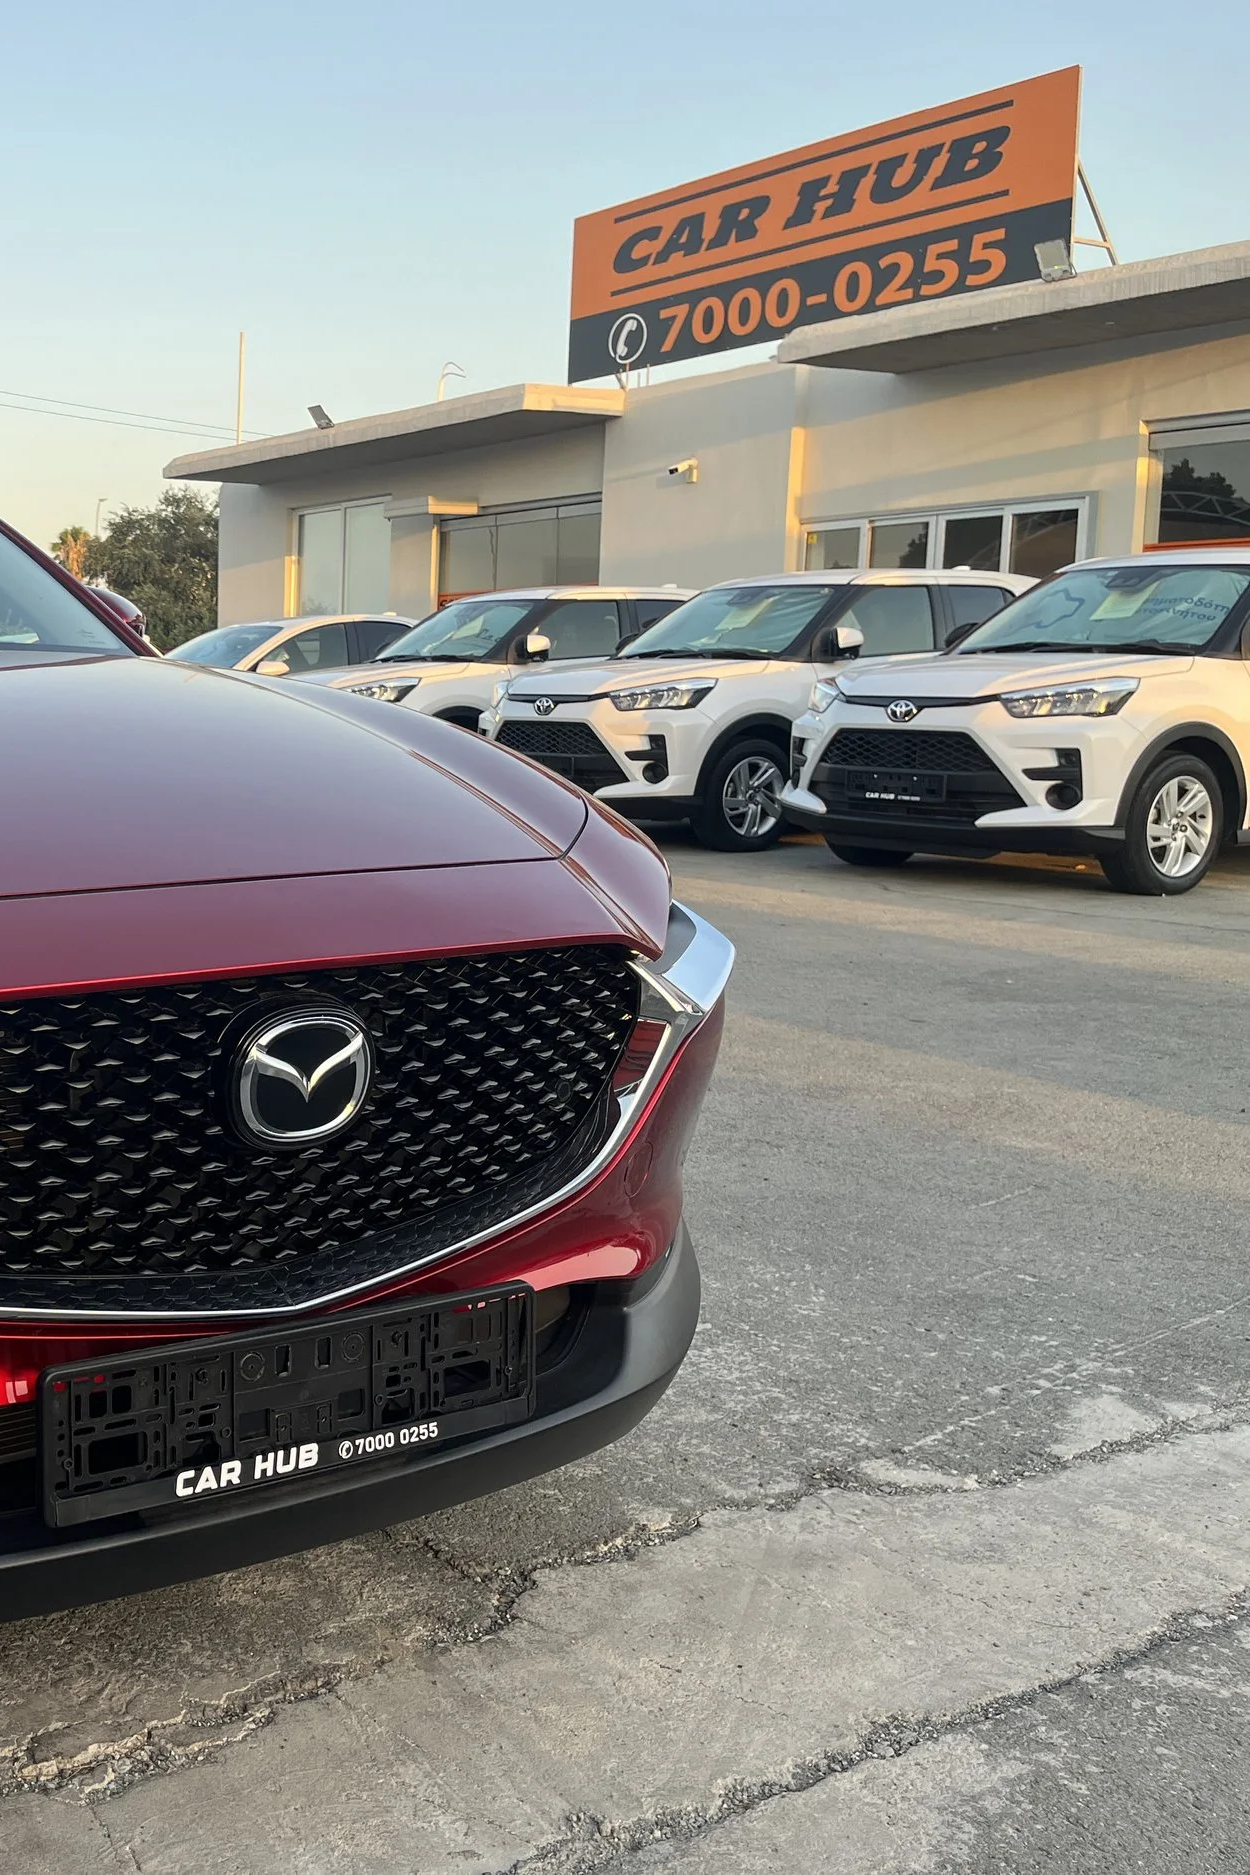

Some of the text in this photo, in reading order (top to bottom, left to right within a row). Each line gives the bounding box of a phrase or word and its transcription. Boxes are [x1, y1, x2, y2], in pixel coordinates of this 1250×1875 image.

[613, 126, 1010, 273] CAR HUB
[659, 228, 1007, 352] 7000-0255
[175, 1421, 439, 1497] CAR HUB 7000 0255
